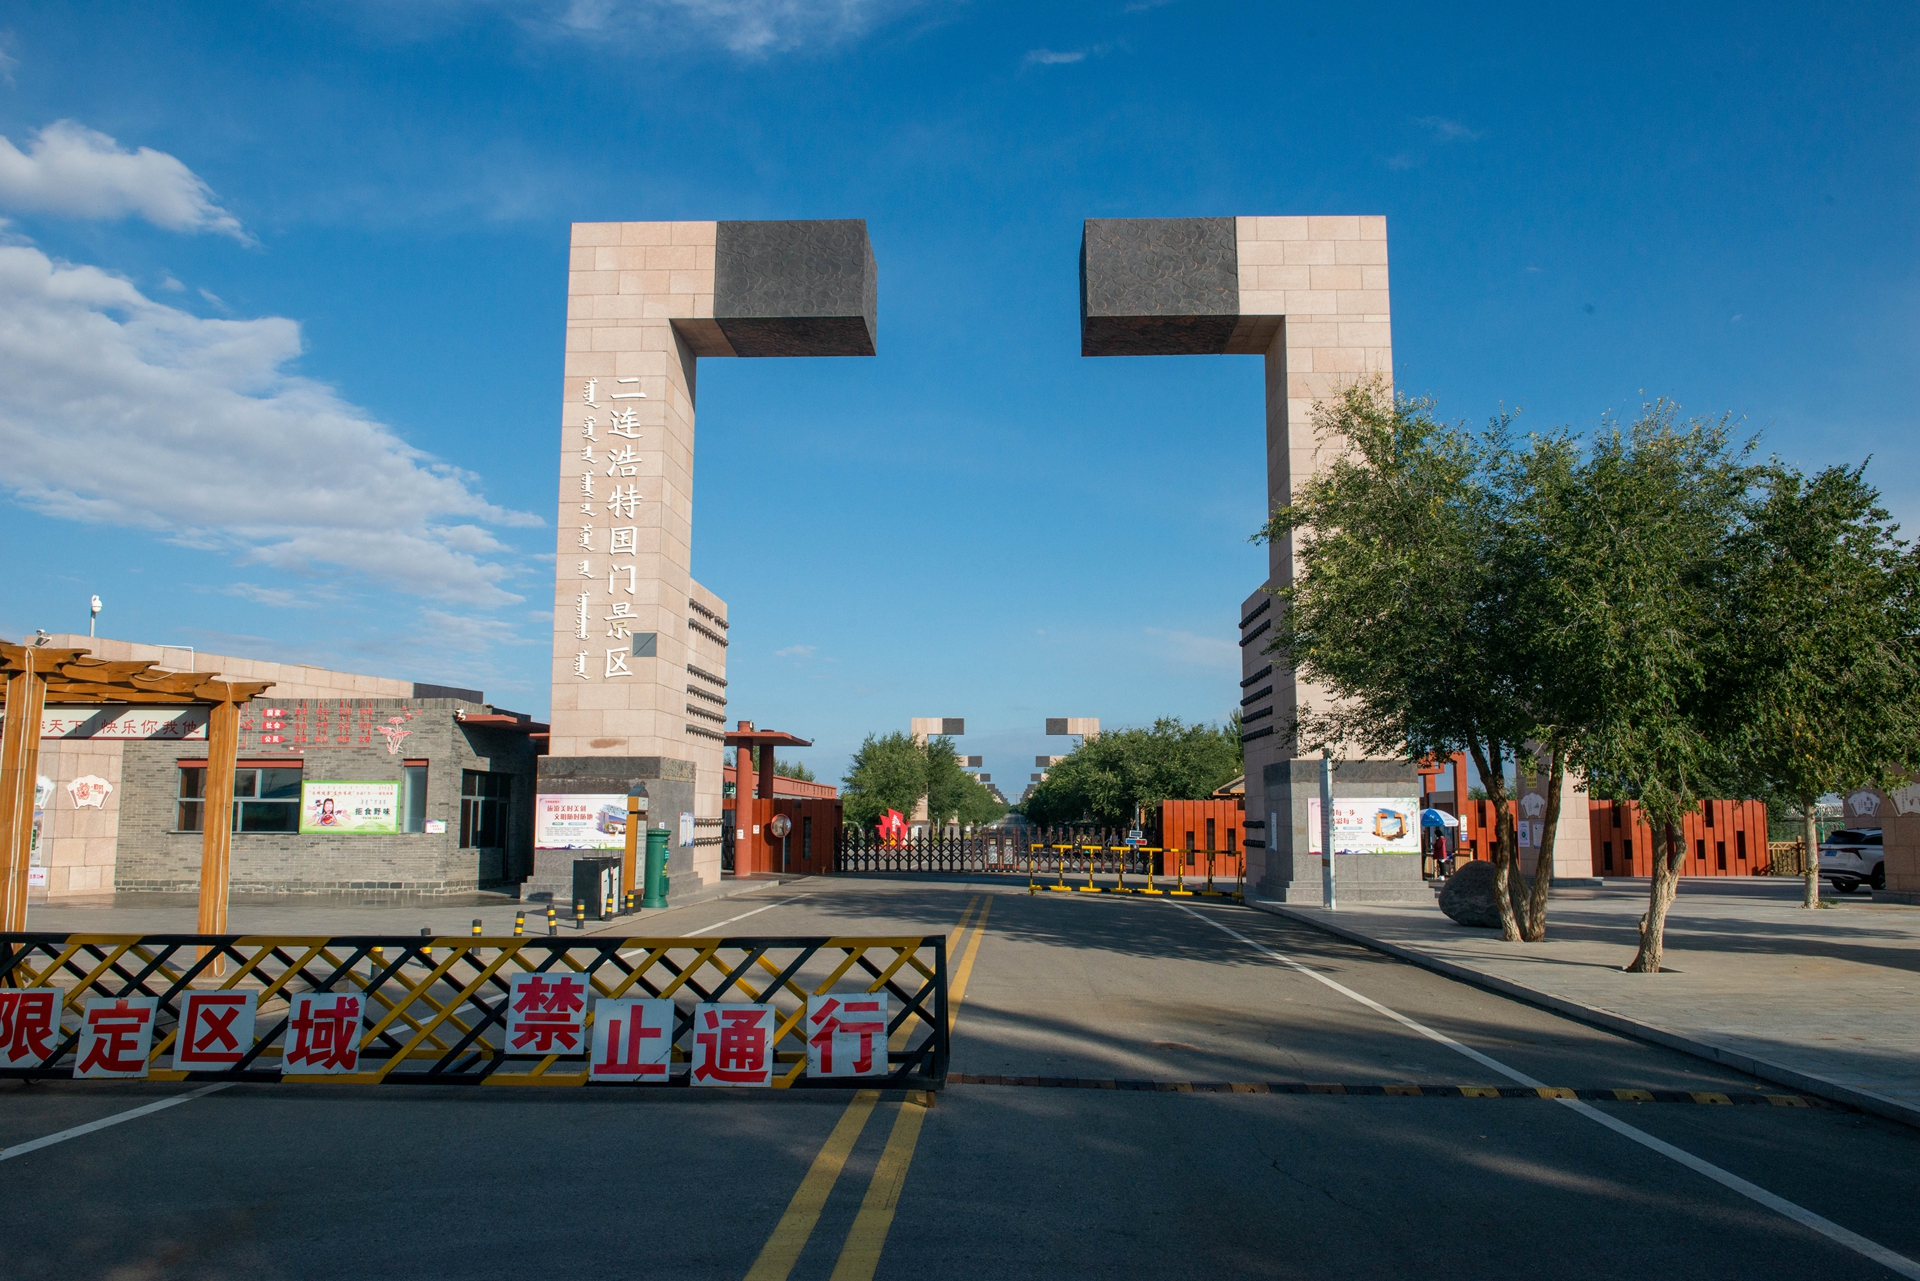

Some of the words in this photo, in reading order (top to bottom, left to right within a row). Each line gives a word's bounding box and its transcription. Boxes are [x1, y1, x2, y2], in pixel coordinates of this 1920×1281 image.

[603, 377, 647, 679] 二连浩特国门景区
[266, 709, 282, 717] 国家
[42, 719, 86, 735] 天下
[101, 719, 200, 735] 快乐你我他
[264, 735, 279, 743] 公民
[355, 807, 391, 815] 拒食野味
[0, 993, 360, 1074] 限定区域
[511, 976, 884, 1083] 禁止通行
